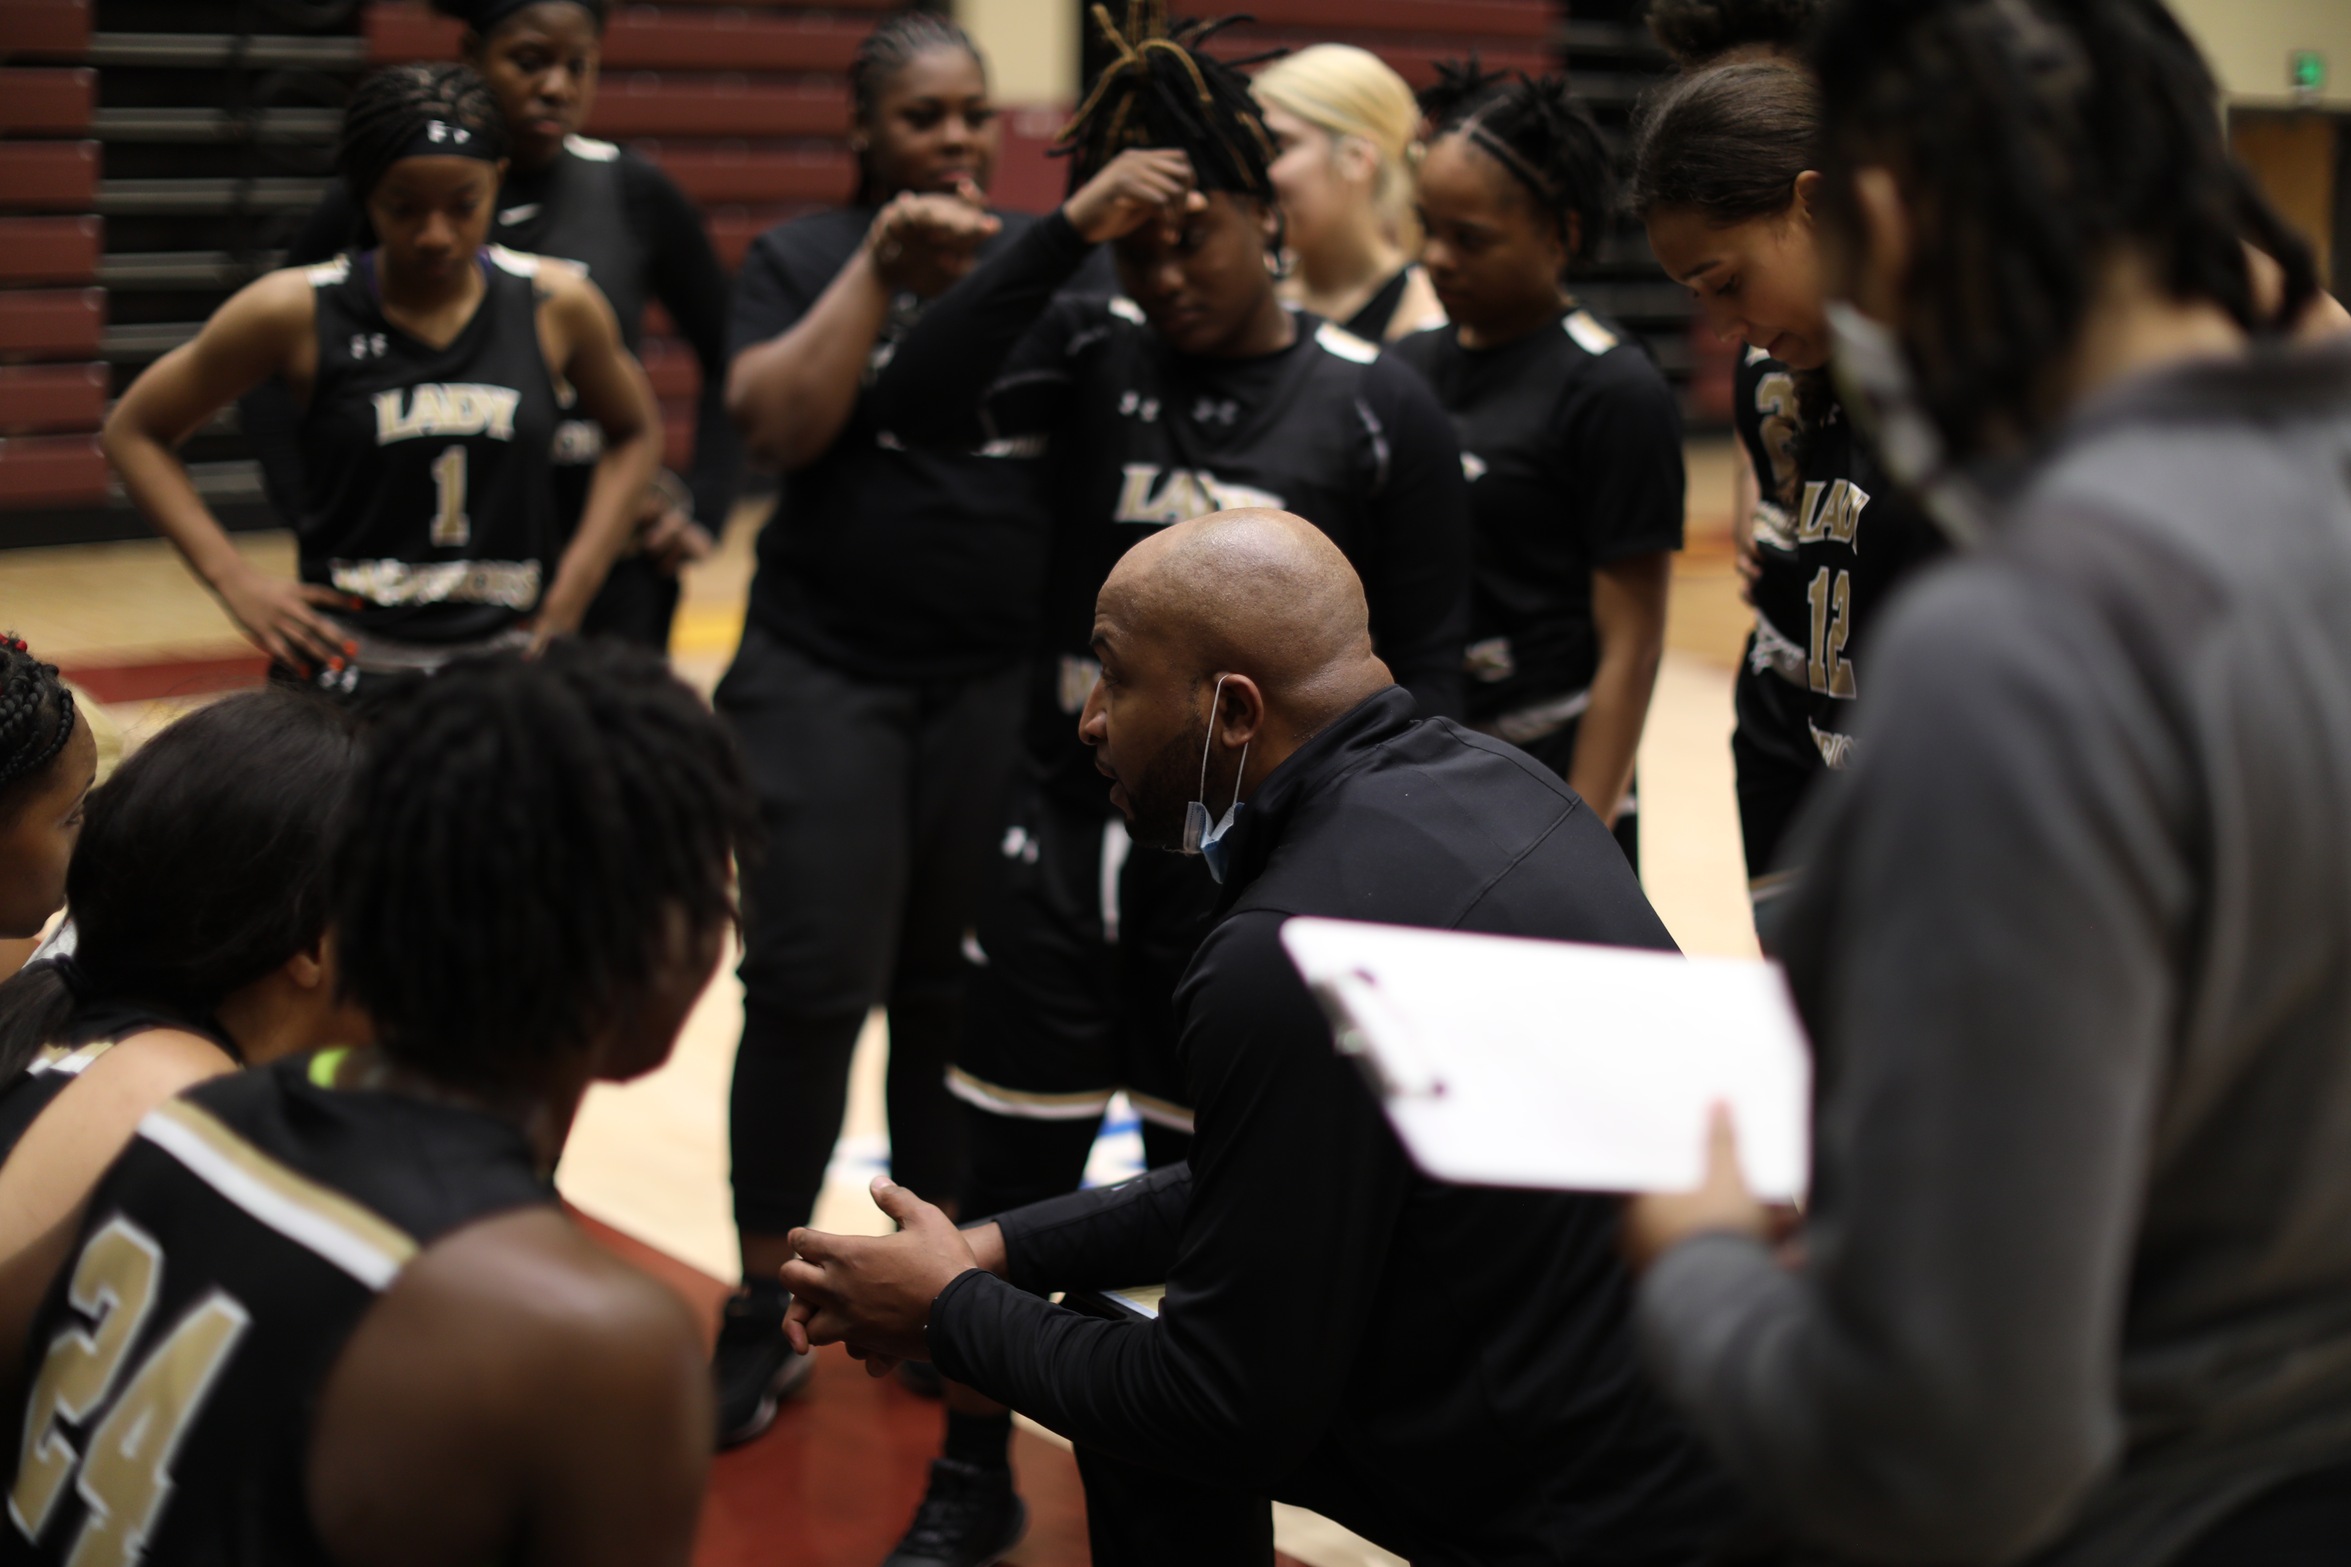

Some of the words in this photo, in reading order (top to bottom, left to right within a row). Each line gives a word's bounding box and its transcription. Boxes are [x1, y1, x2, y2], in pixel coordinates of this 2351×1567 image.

[372, 383, 521, 445] LADY
[430, 445, 471, 547] 1
[1113, 463, 1285, 524] LA
[1807, 566, 1856, 699] 12
[7, 1216, 252, 1567] 24
